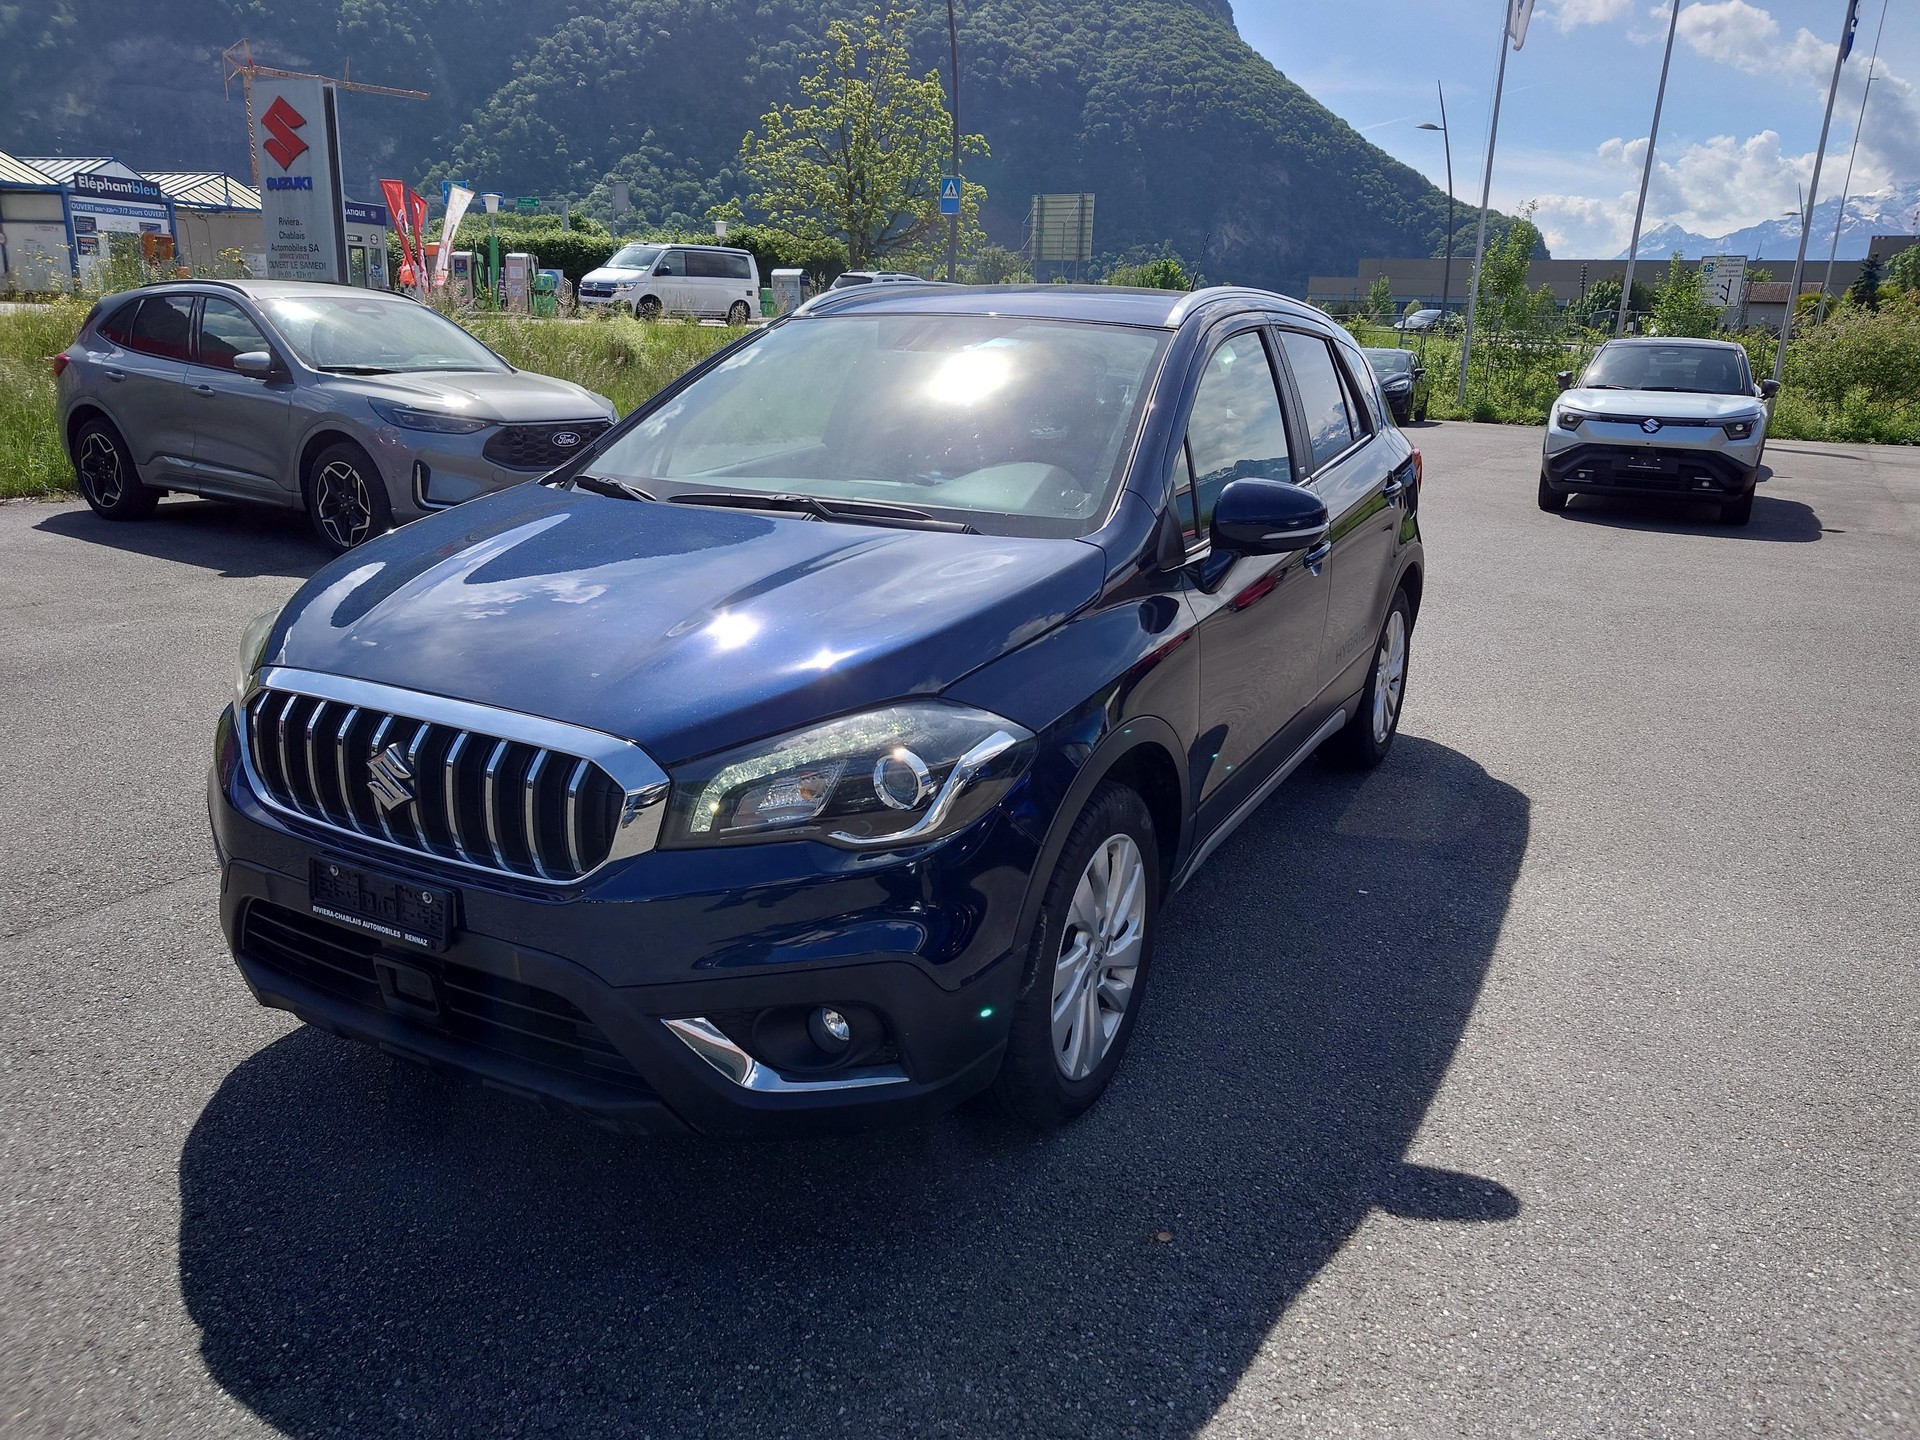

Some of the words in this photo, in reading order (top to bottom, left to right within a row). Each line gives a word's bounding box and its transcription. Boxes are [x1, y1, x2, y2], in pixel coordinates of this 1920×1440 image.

[266, 177, 312, 191] SUZUKI
[72, 203, 94, 211] OUVERT
[345, 209, 366, 217] ATIQUE
[278, 230, 305, 240] Chablais
[271, 244, 307, 252] Automobiles
[309, 244, 320, 252] SA
[269, 261, 289, 269] OUVERT
[291, 261, 298, 269] LE
[300, 261, 326, 270] SAMEDI
[312, 905, 362, 926] RIVIERA-CHABLAIS
[363, 920, 401, 938] AUTOMOBILES
[404, 933, 428, 946] RENNAZ
